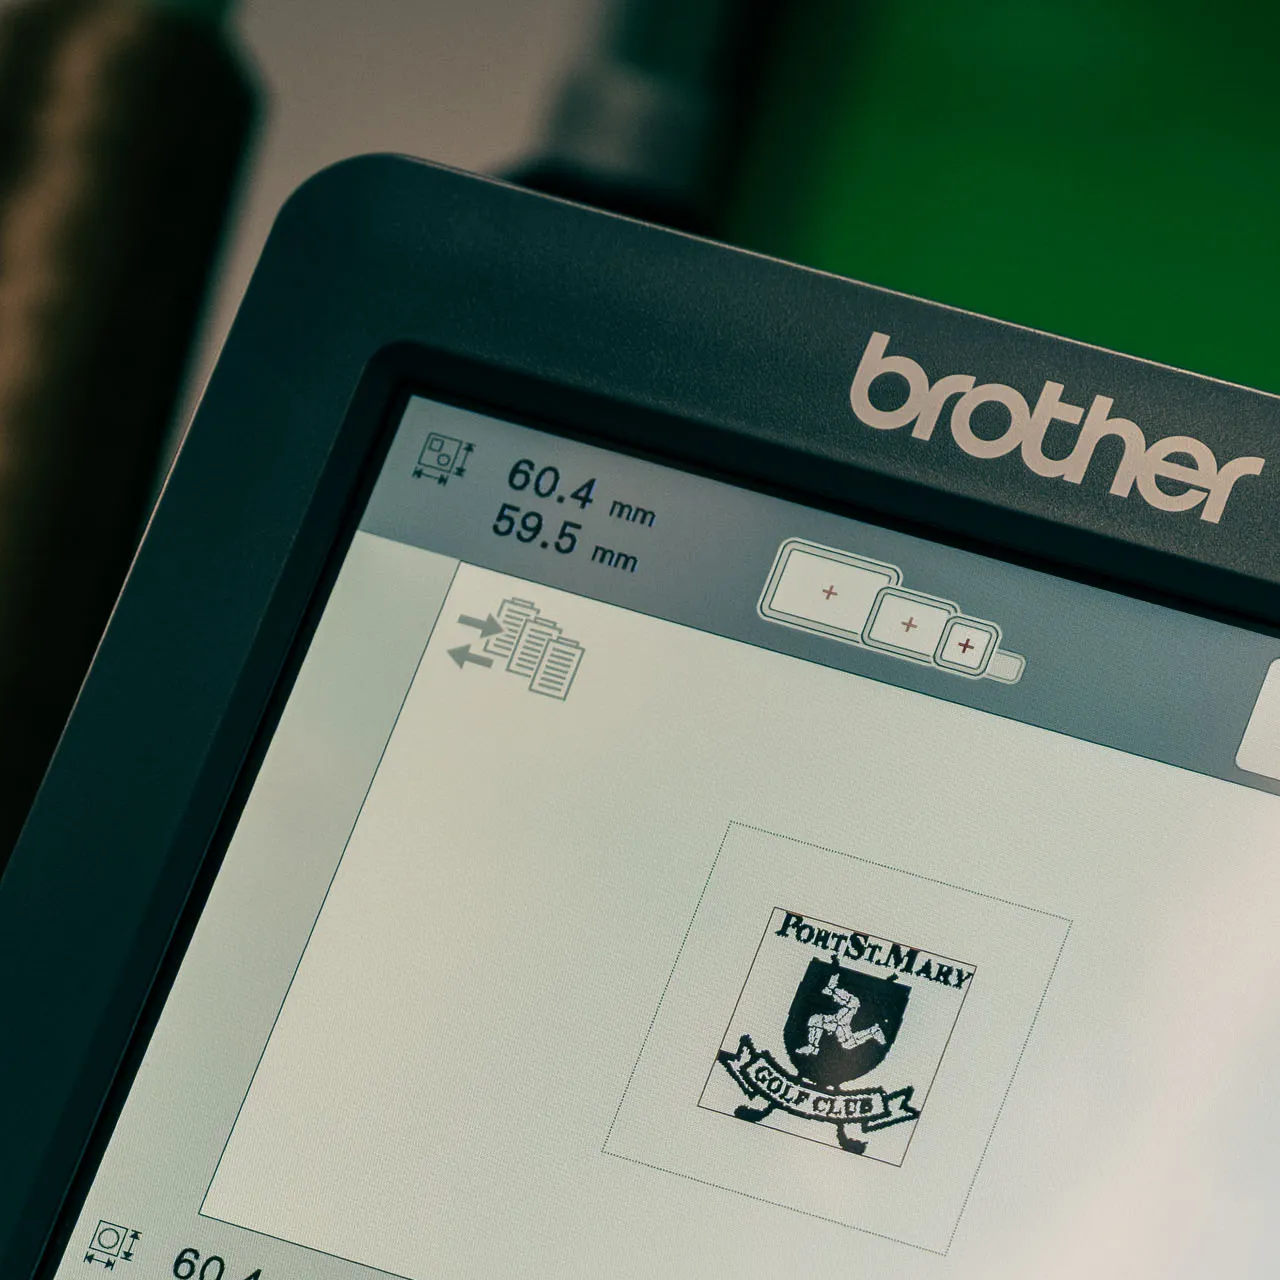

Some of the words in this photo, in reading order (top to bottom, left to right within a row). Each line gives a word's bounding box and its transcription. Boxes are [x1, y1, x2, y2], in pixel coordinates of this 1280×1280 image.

[850, 331, 1265, 524] brother
[507, 457, 597, 511] 60.4
[609, 496, 658, 528] mm
[491, 503, 582, 556] 59.5
[591, 541, 639, 573] mm
[754, 1065, 810, 1104] GOLF
[812, 1097, 872, 1115] CLUB
